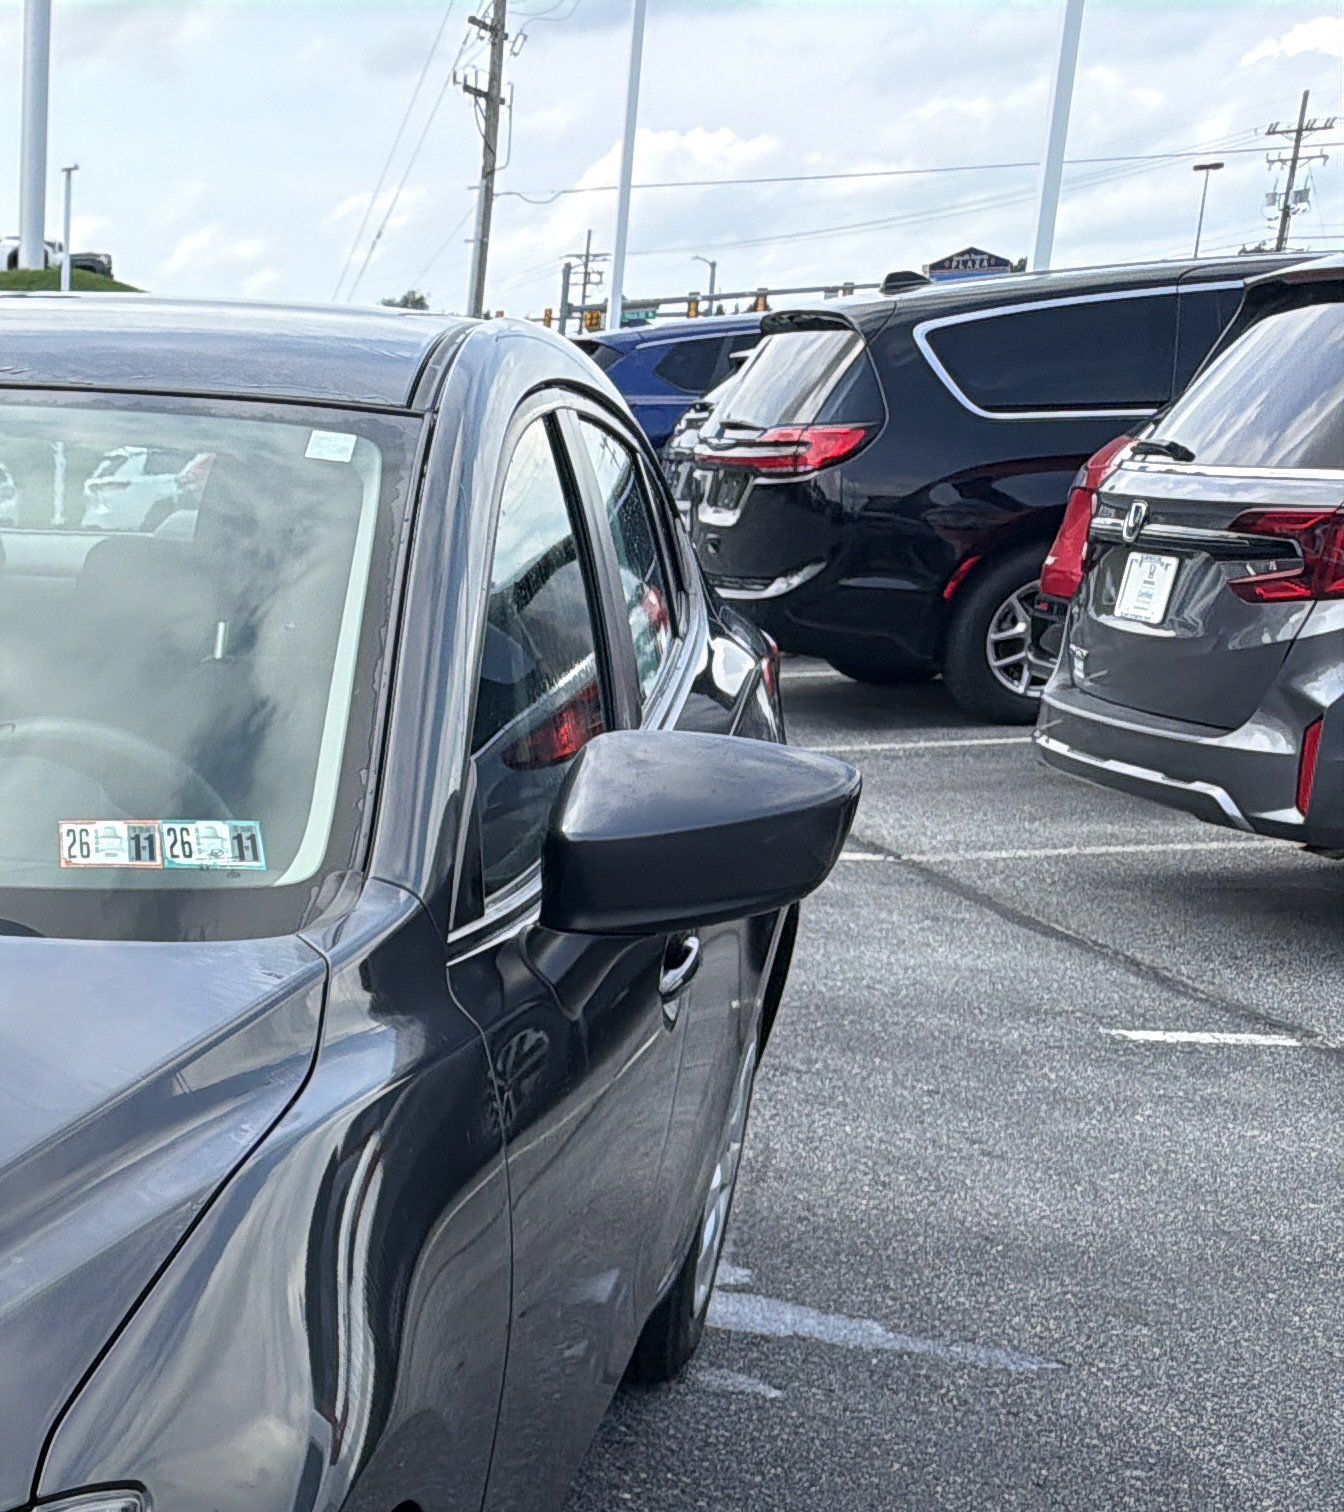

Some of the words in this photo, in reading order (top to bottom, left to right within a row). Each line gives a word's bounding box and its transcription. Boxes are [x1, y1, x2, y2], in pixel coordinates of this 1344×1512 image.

[66, 828, 91, 859] 26
[129, 833, 155, 862] 11
[166, 827, 193, 859] 26
[232, 832, 260, 862] 11
